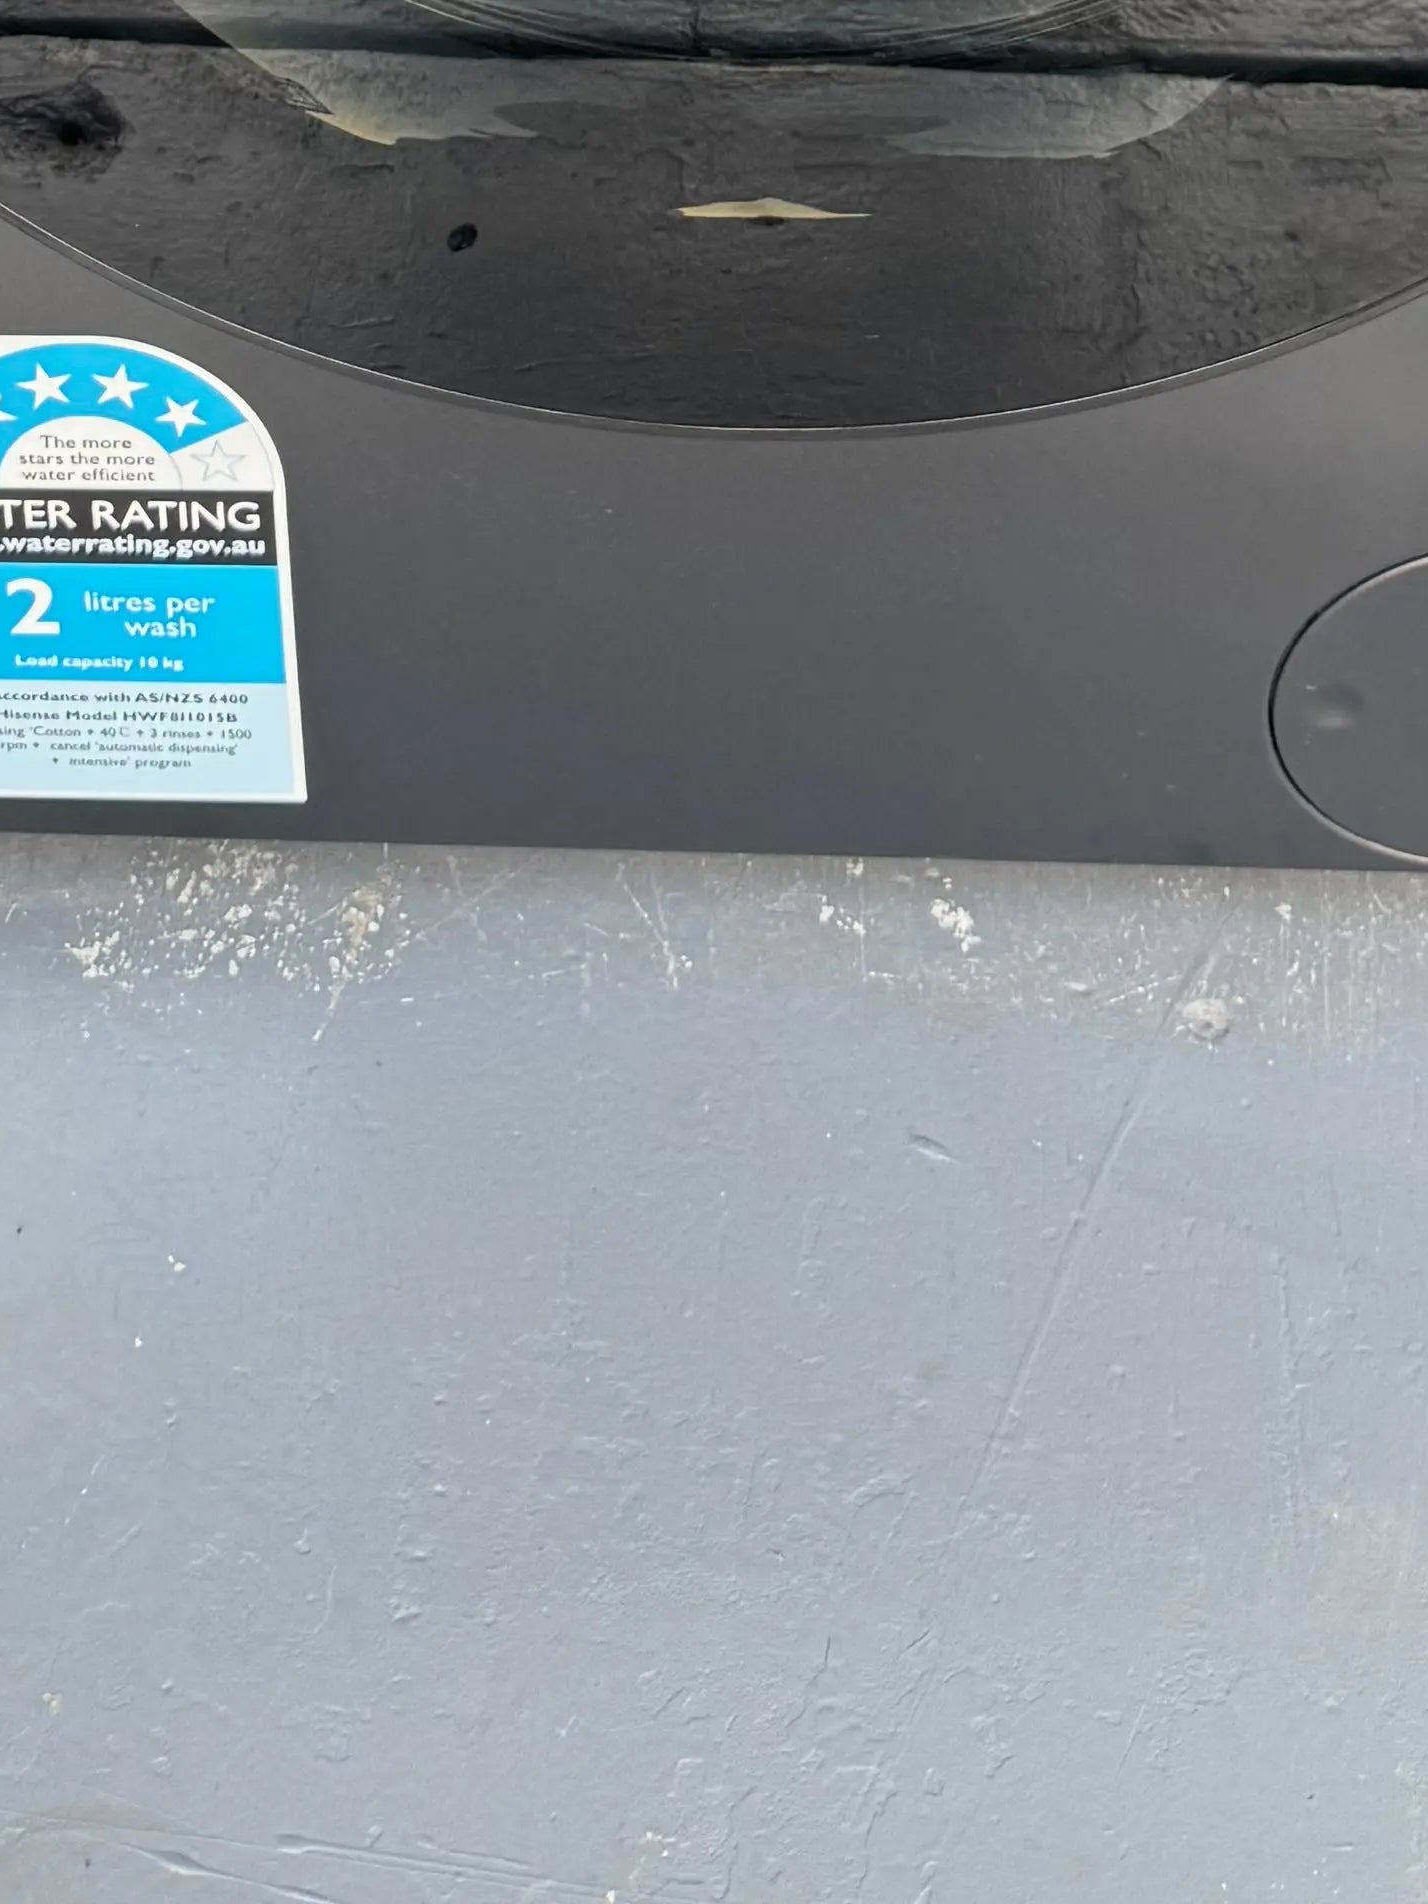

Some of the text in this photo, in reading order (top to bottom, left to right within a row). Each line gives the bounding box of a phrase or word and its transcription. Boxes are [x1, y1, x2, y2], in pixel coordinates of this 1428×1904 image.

[40, 434, 132, 450] The more
[19, 451, 156, 466] stars the more
[20, 467, 156, 483] water efficient
[91, 499, 262, 532] RATING
[84, 590, 217, 618] litres per
[124, 615, 197, 639] wash
[14, 654, 185, 672] Load capacity 10 kg
[94, 691, 131, 703] with
[135, 692, 204, 704] AS/NZS
[209, 693, 249, 705] 6400
[66, 709, 118, 722] Model
